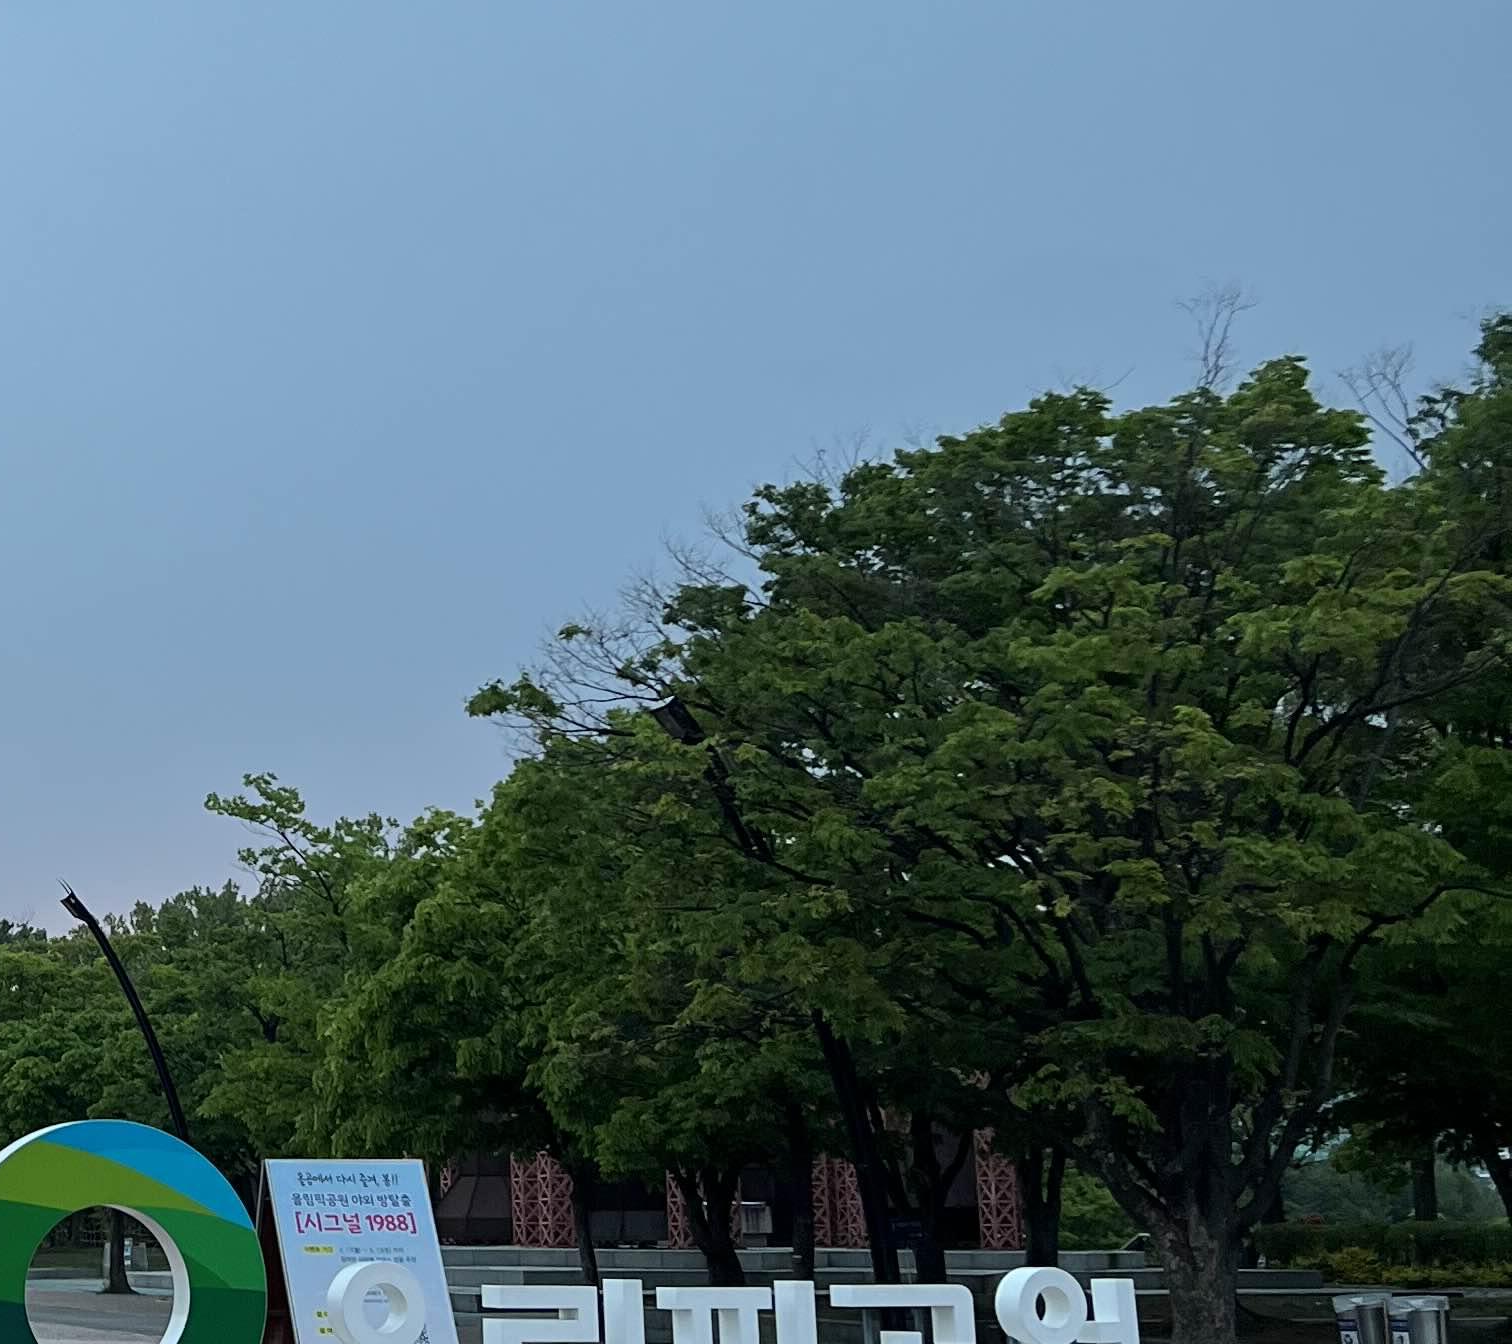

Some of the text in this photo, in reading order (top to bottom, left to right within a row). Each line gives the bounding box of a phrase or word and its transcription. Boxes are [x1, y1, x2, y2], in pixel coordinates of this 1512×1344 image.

[336, 1173, 356, 1185] 다시
[292, 1192, 411, 1207] 올림픽공원 야외 방탈출
[295, 1211, 417, 1234] [시그널 1988]
